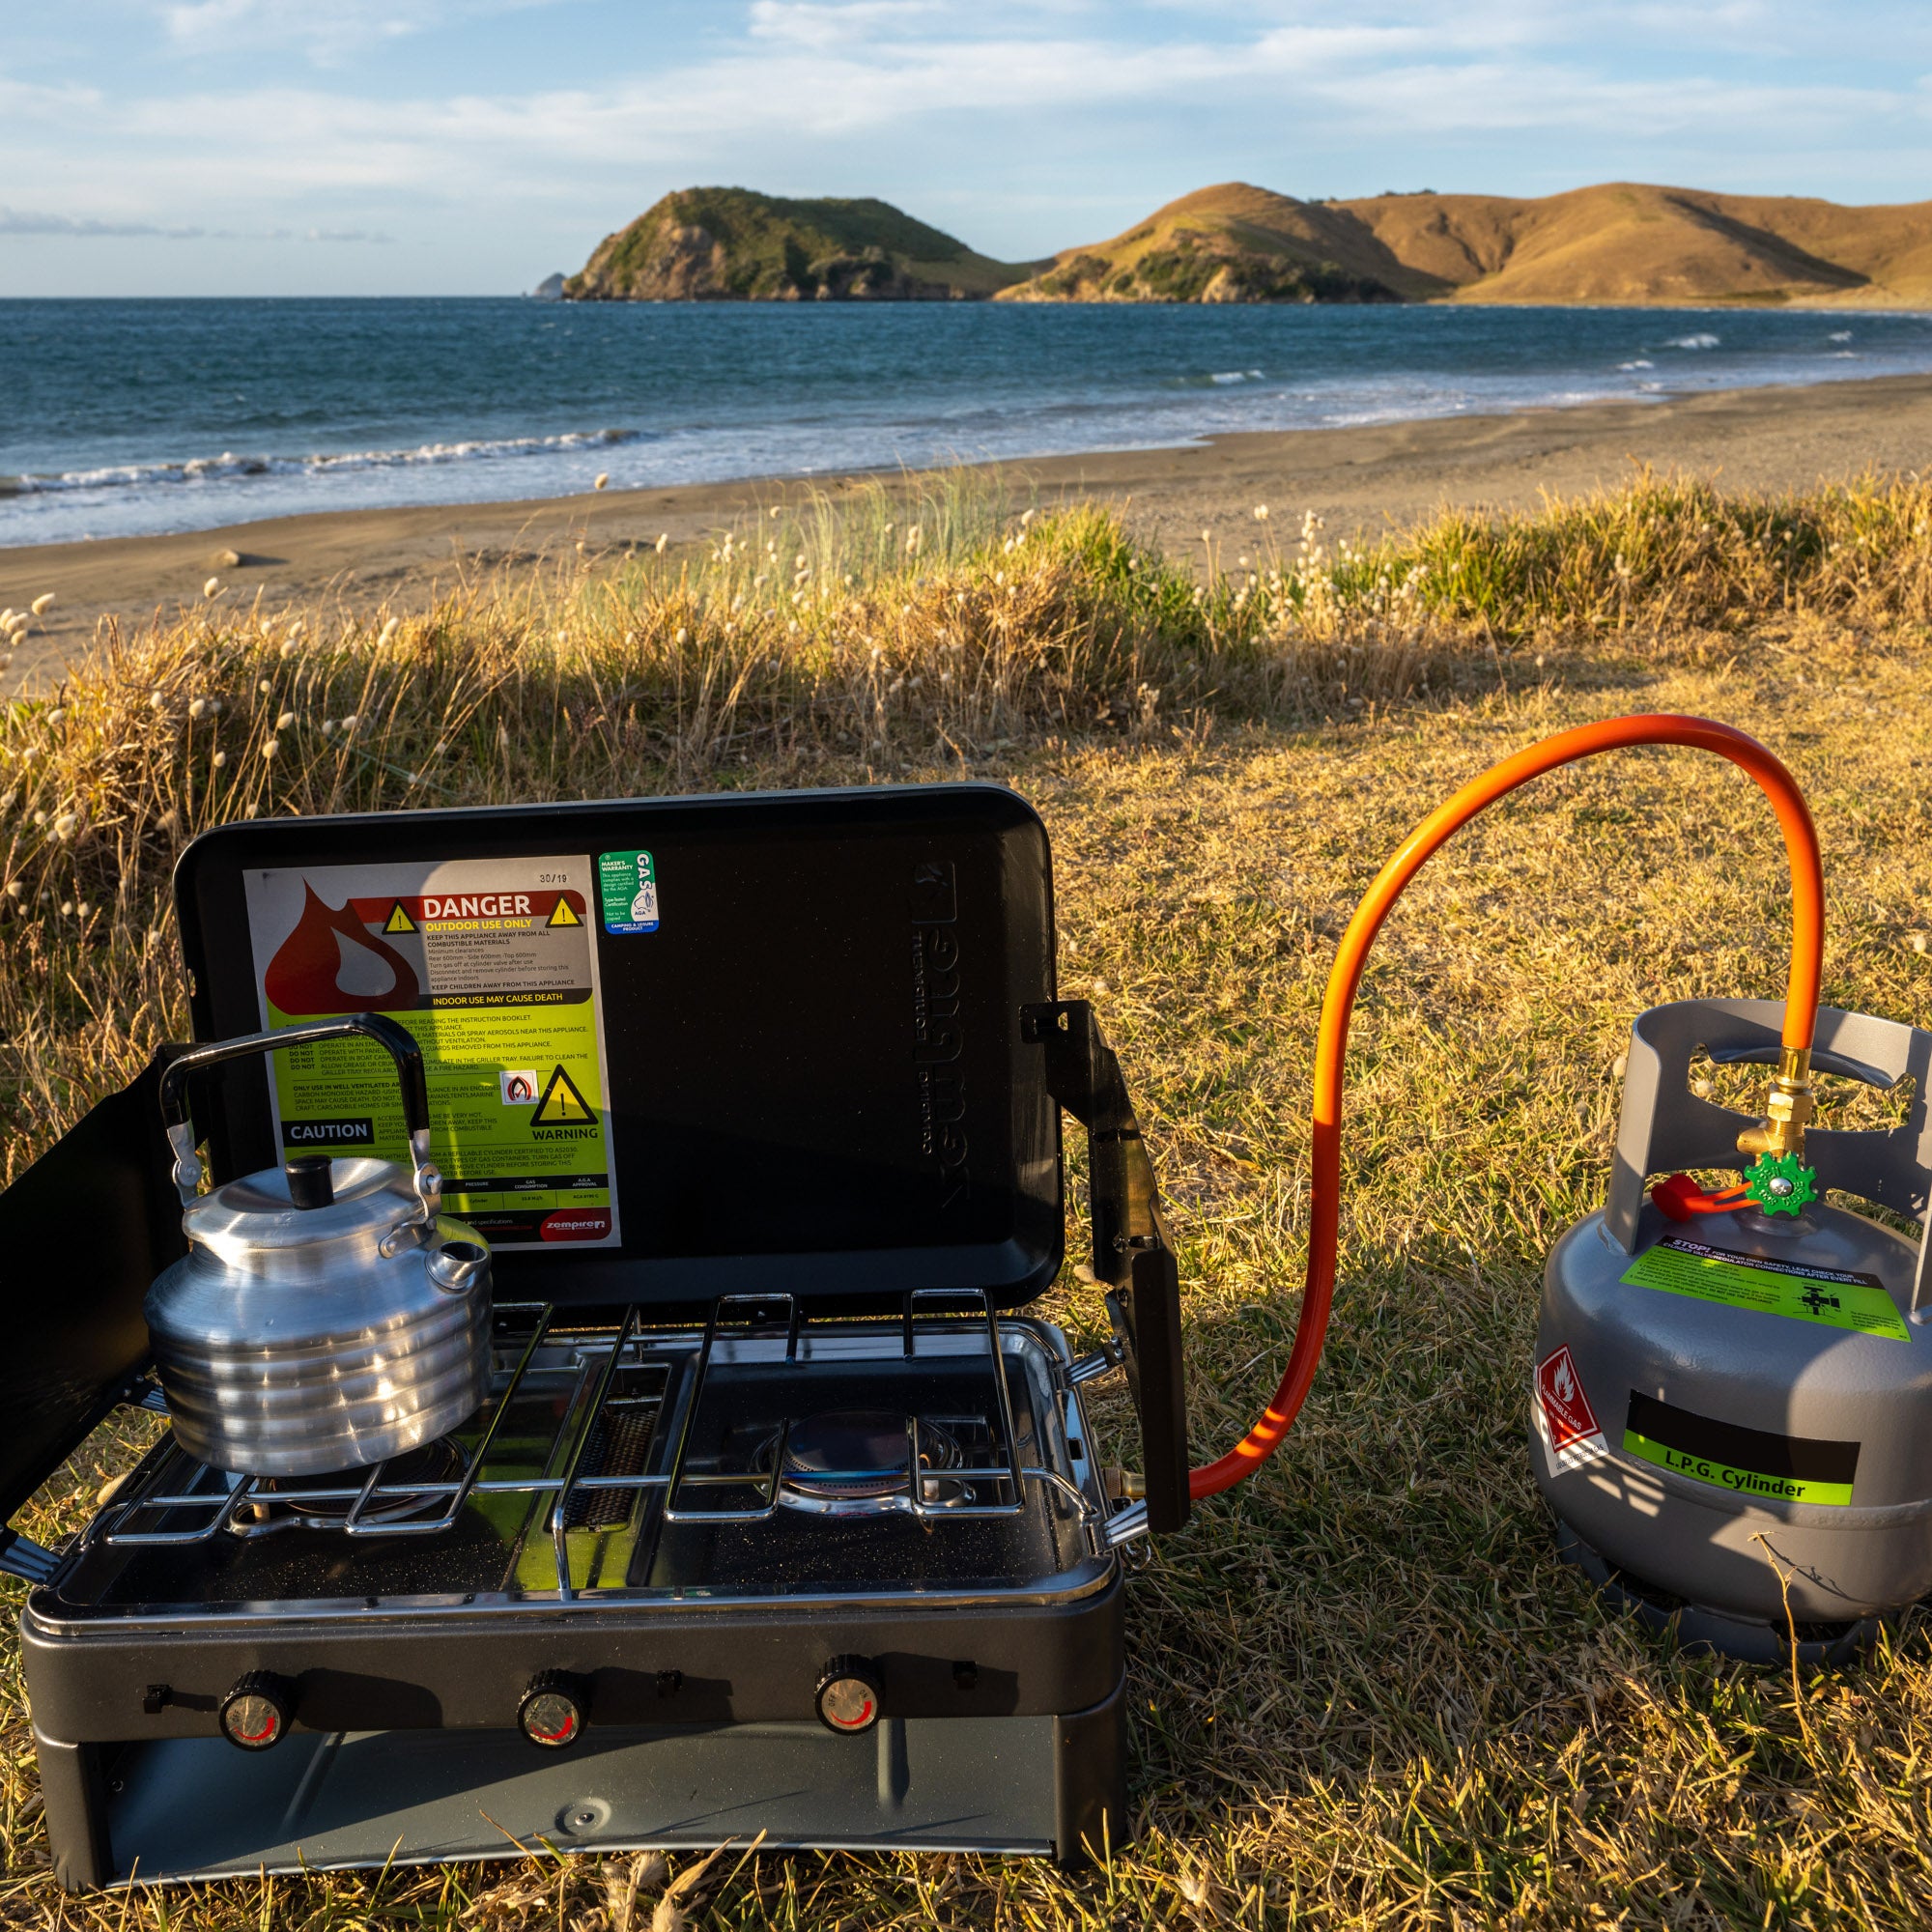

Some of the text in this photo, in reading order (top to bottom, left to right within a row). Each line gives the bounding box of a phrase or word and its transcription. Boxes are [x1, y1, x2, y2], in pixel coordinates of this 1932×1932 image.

[539, 873, 567, 884] 30/19
[637, 853, 652, 890] GAS
[423, 895, 530, 918] DANGER
[424, 919, 532, 932] OUTDOOR USE ONLY
[433, 997, 467, 1006] INDOOR
[534, 992, 562, 1001] DEATH
[290, 1122, 367, 1139] CAUTION
[531, 1127, 597, 1141] WARNING
[546, 1220, 594, 1231] zempire
[1672, 1238, 1712, 1253] STOP!
[1754, 1264, 1805, 1276] CONNECTIONS
[1541, 1383, 1582, 1431] FLAMMABLE GAS
[1593, 1443, 1604, 1453] GAS
[1664, 1450, 1806, 1498] L.P.G. Cylinder
